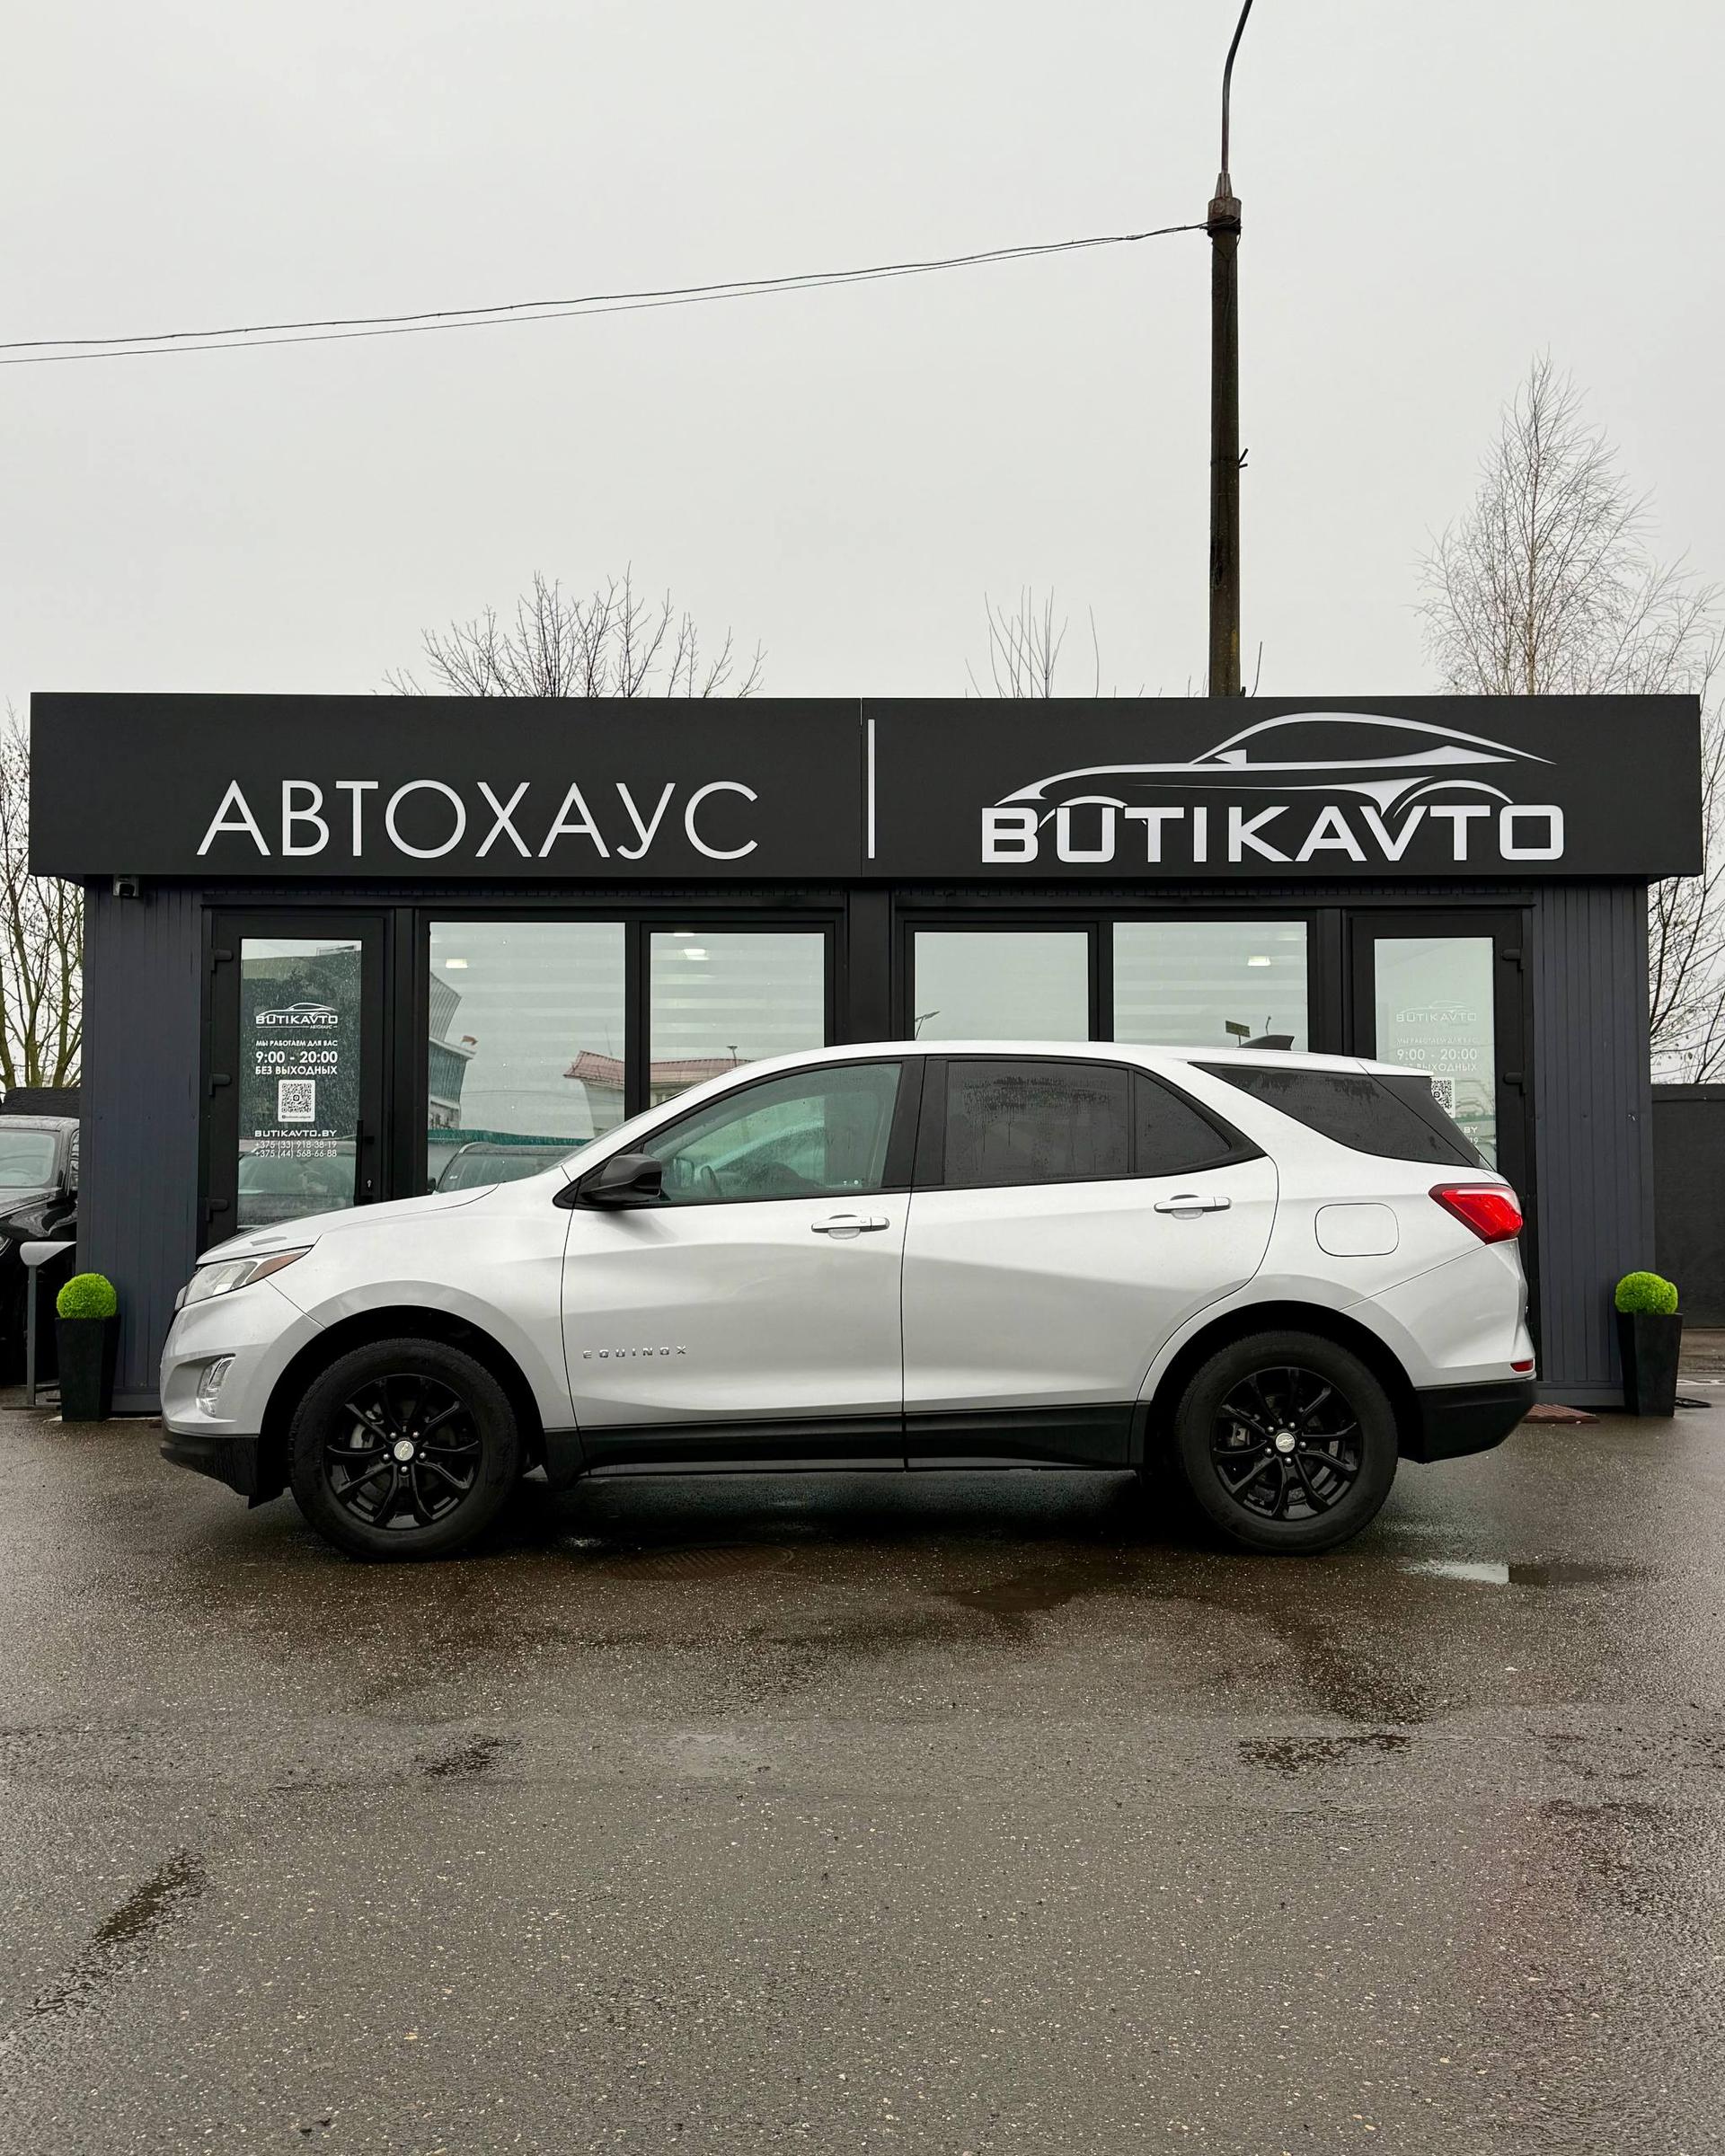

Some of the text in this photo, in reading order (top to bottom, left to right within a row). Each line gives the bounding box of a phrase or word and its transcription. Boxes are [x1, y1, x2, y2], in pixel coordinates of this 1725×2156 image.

[197, 779, 758, 860] АВТОХАУС
[981, 803, 1565, 864] BUTIKAVTO
[255, 1015, 338, 1024] BUTIKAVTO
[1396, 1012, 1477, 1022] BUTIKAVTO
[255, 1051, 286, 1064] 9:00
[299, 1051, 338, 1064] 20:00
[1397, 1048, 1425, 1061] 9:00
[1440, 1048, 1478, 1060] 20:00
[255, 1065, 338, 1076] БЕЗ ВЫХОДНЫХ
[255, 1129, 338, 1137] BUTIKAVTO.BY
[255, 1140, 337, 1151] +375 (33) 918-38-19
[255, 1149, 338, 1159] +375 (44) 568-66-88
[582, 1345, 686, 1359] EQUINOX
